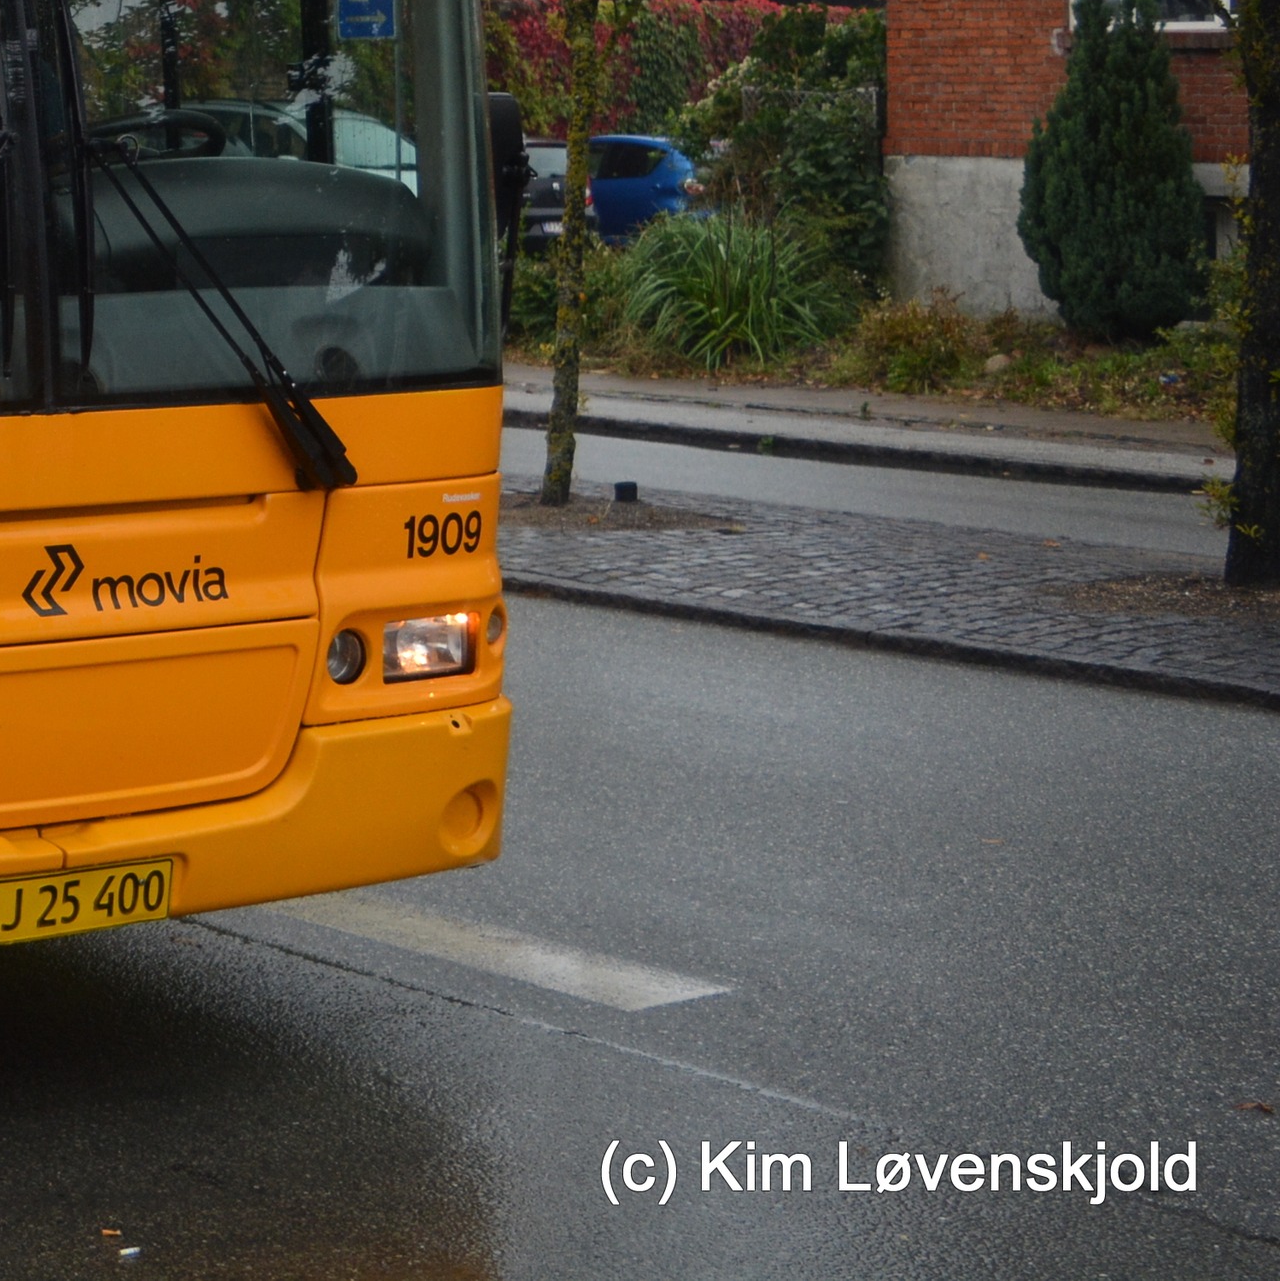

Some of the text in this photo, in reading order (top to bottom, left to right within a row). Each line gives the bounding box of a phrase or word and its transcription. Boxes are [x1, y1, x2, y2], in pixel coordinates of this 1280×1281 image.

[403, 509, 483, 560] 1909
[92, 554, 230, 612] movia
[36, 879, 81, 928] 25
[93, 869, 165, 918] 400
